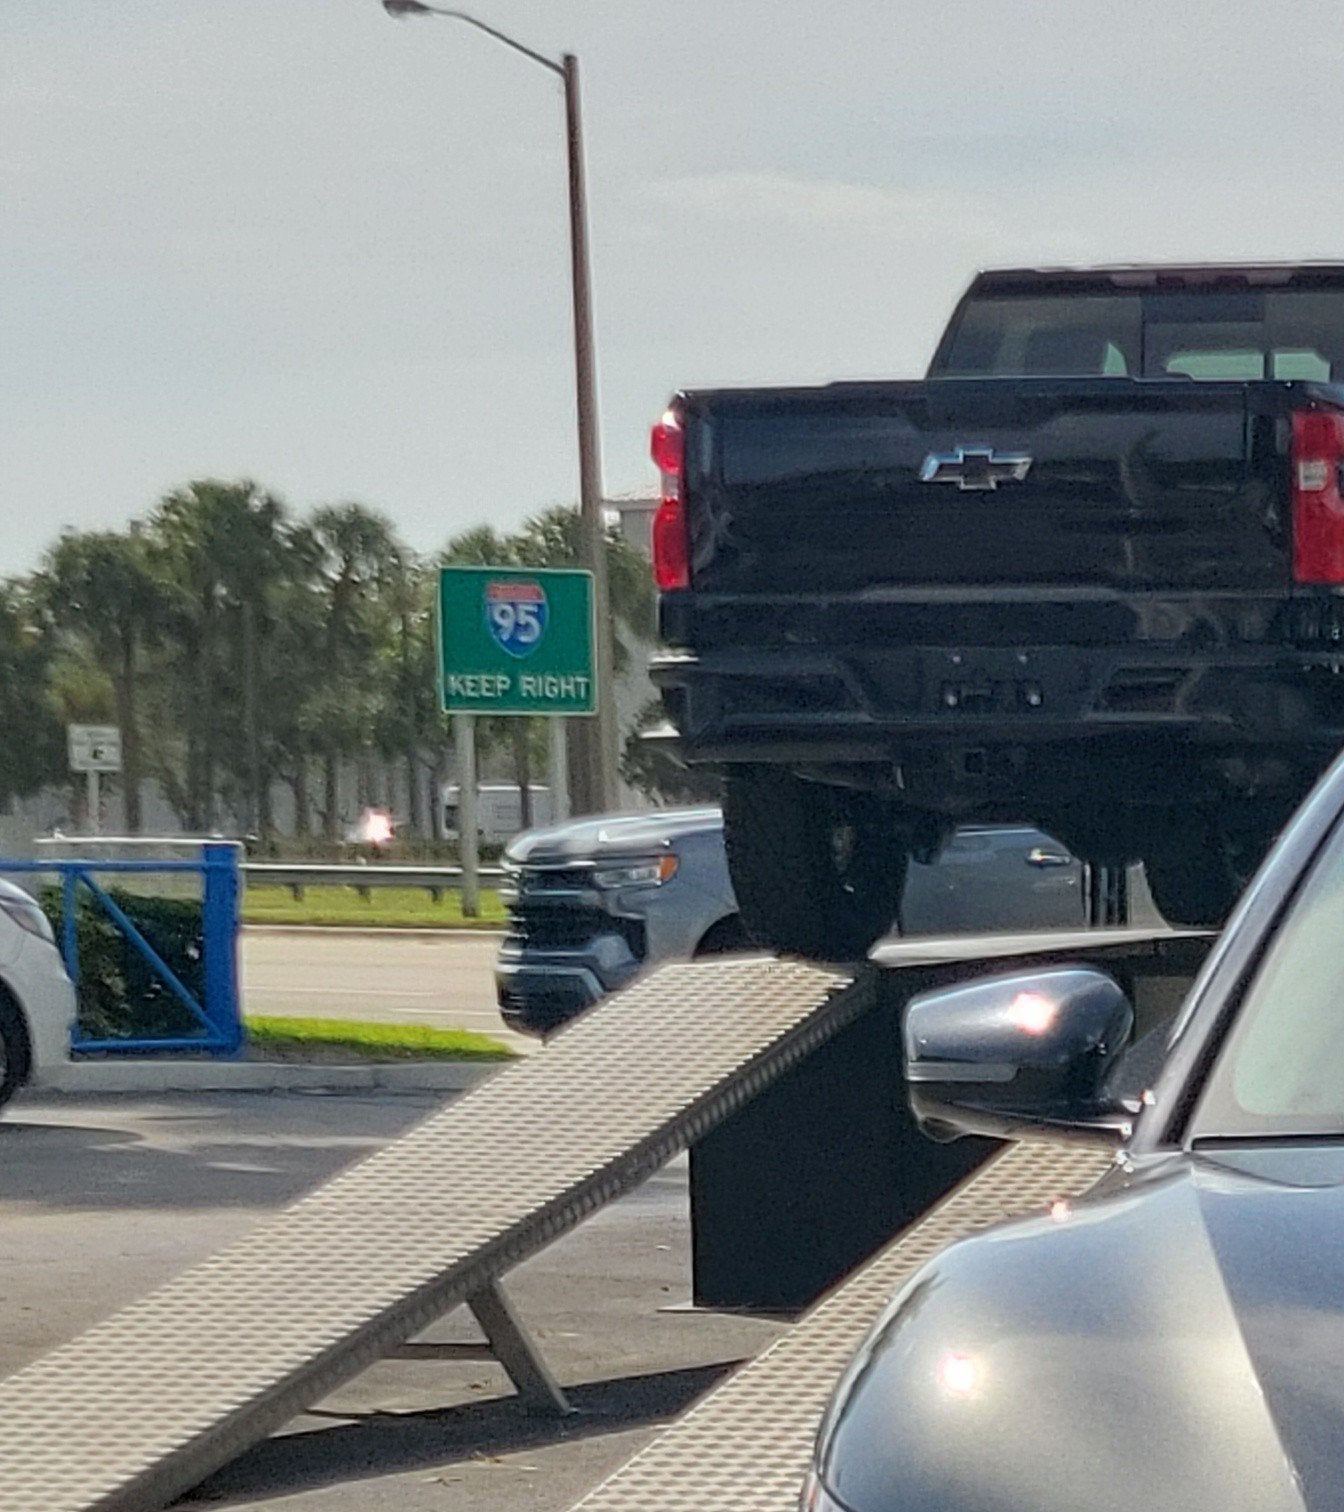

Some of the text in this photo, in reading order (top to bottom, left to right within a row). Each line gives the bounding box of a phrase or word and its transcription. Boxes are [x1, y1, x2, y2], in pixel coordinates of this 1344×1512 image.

[492, 603, 541, 643] 95
[449, 674, 590, 699] KEEP RIGHT
